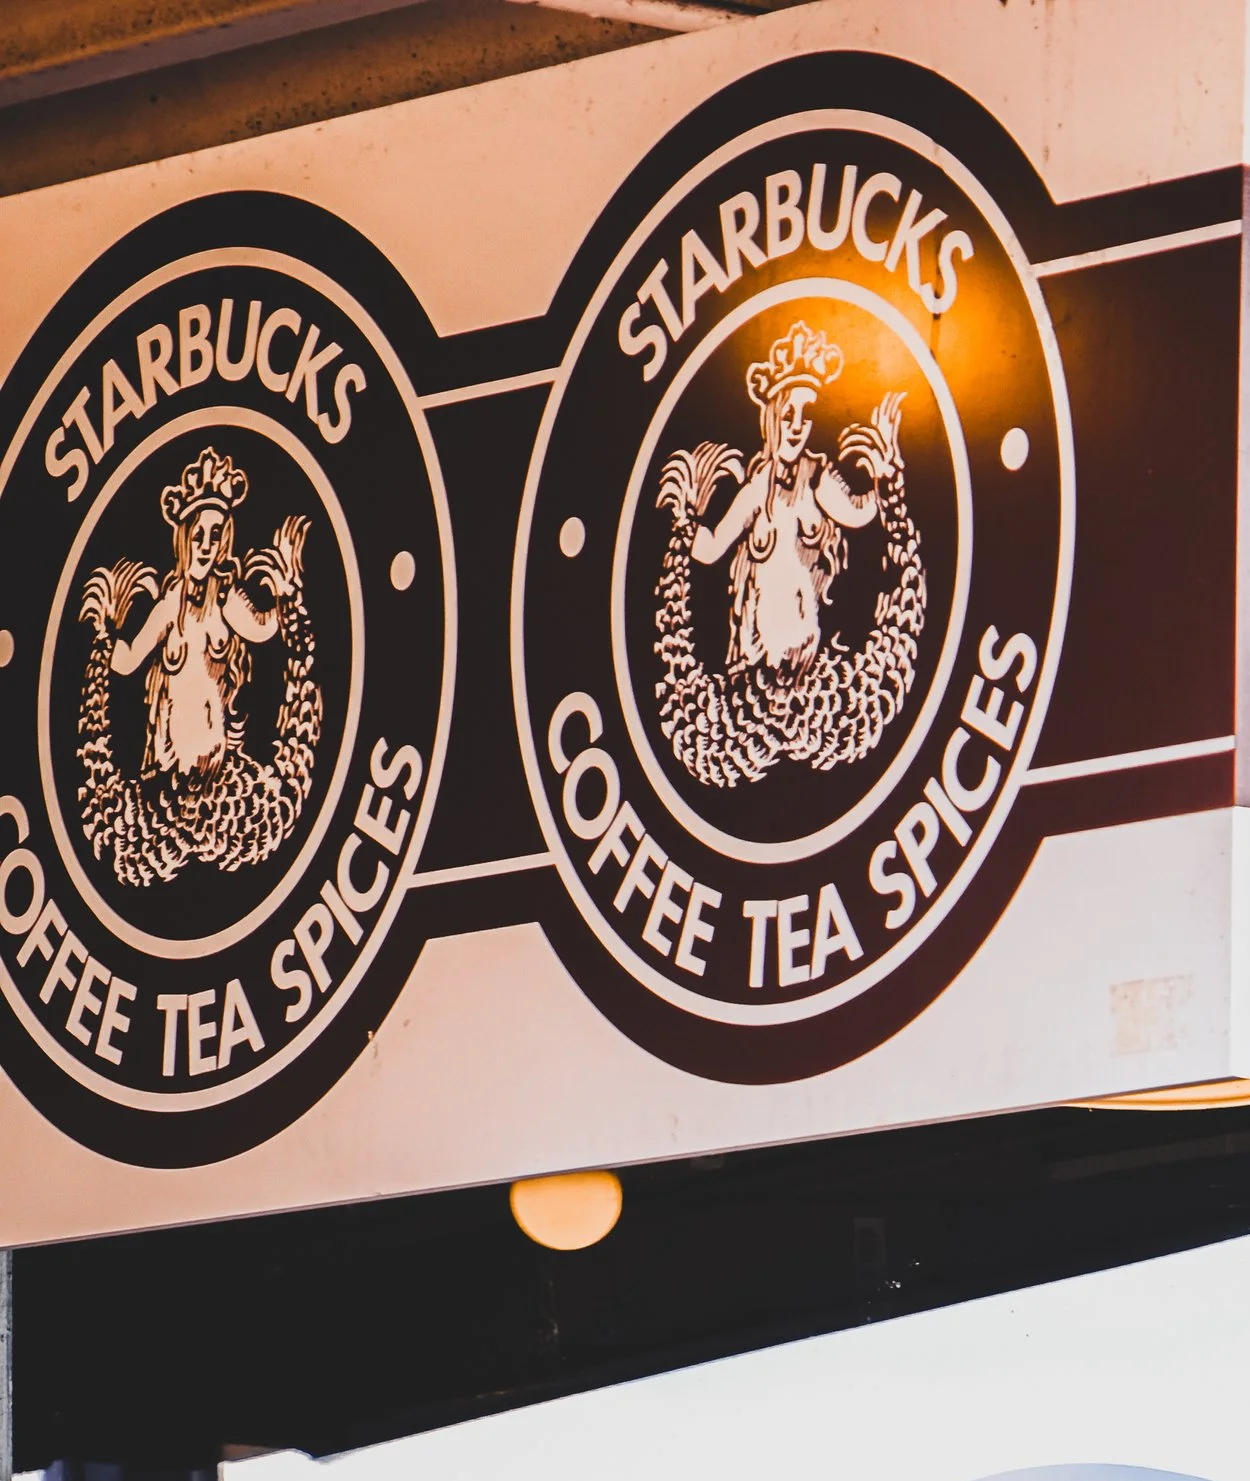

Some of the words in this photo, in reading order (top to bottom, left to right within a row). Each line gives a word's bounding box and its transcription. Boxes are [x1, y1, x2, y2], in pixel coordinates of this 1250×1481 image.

[44, 298, 366, 501] STARBUCKS
[617, 162, 974, 382] STARBUCKS
[156, 978, 266, 1077] TEA
[270, 736, 424, 1023] SPICES
[547, 689, 727, 977] COFFEE
[741, 883, 861, 989] TEA
[868, 624, 1038, 931] SPICES
